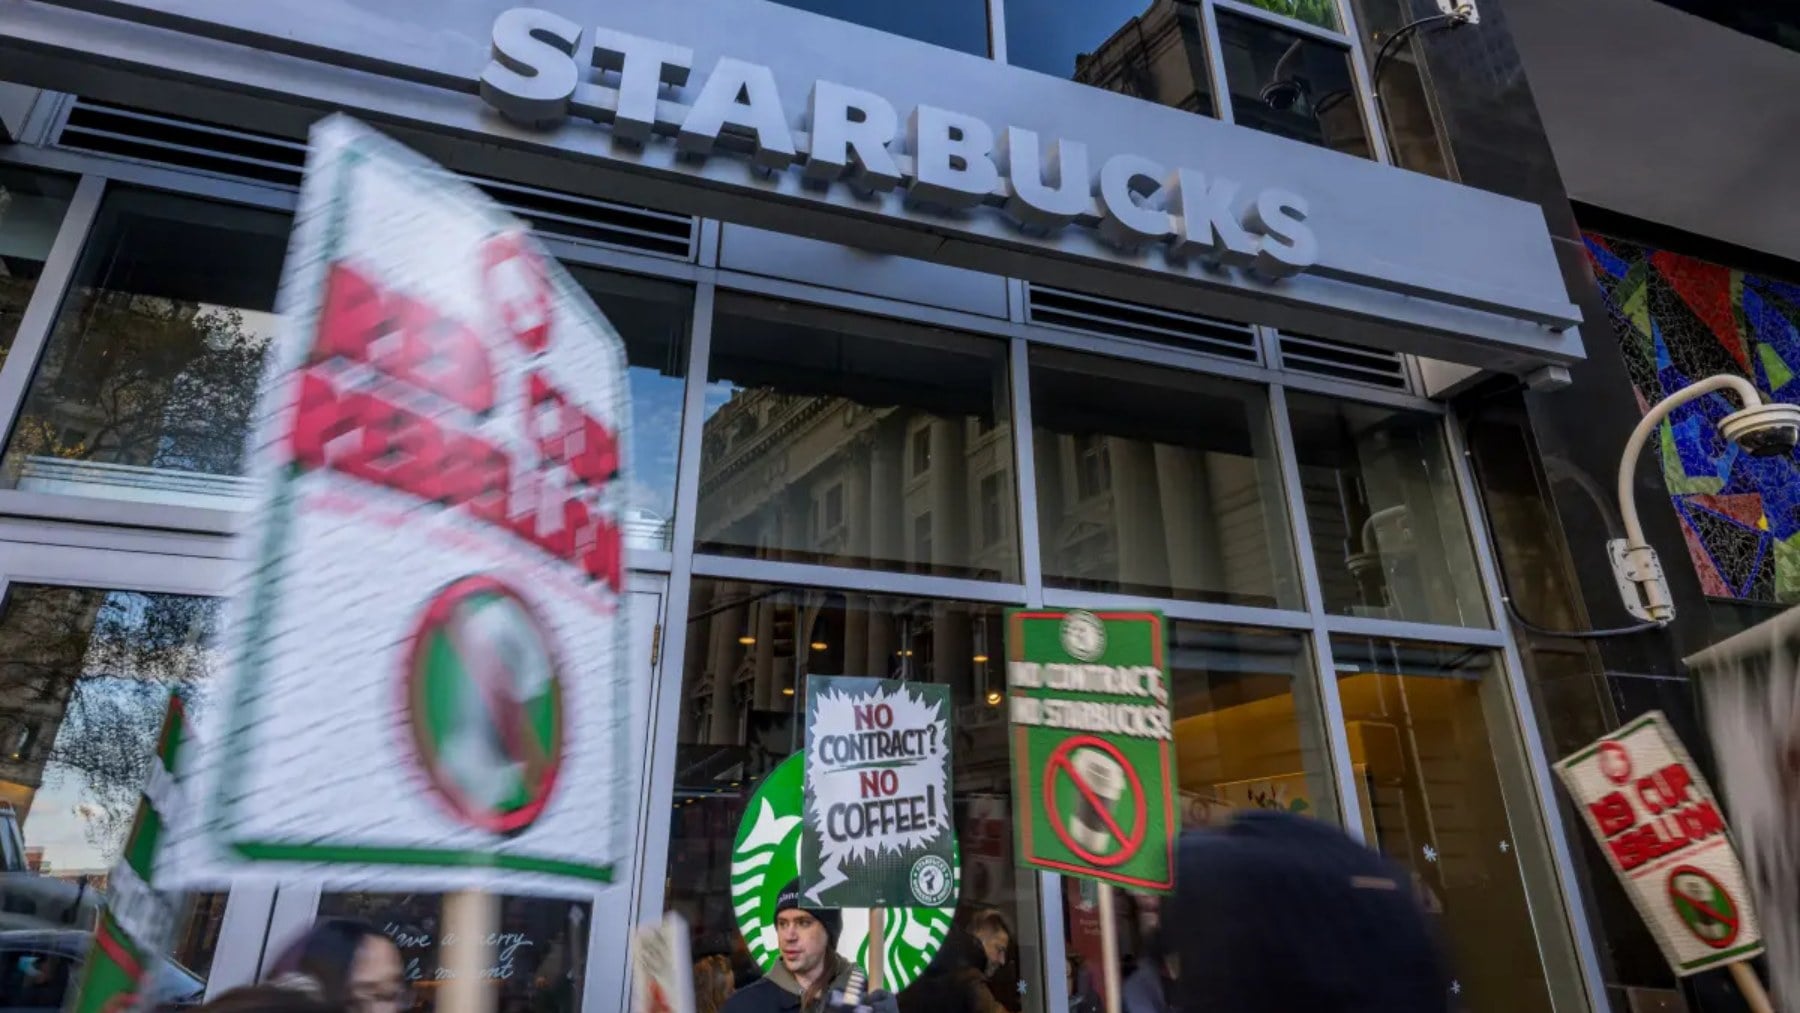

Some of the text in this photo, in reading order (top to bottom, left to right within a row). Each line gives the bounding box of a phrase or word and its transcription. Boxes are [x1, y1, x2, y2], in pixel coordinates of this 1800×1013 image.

[482, 6, 1318, 271] STARBUCKS
[853, 703, 893, 731] NO
[818, 723, 938, 765] CONTRACT?
[860, 769, 899, 799] NO
[826, 784, 938, 843] COFFEE!
[480, 931, 533, 960] erry
